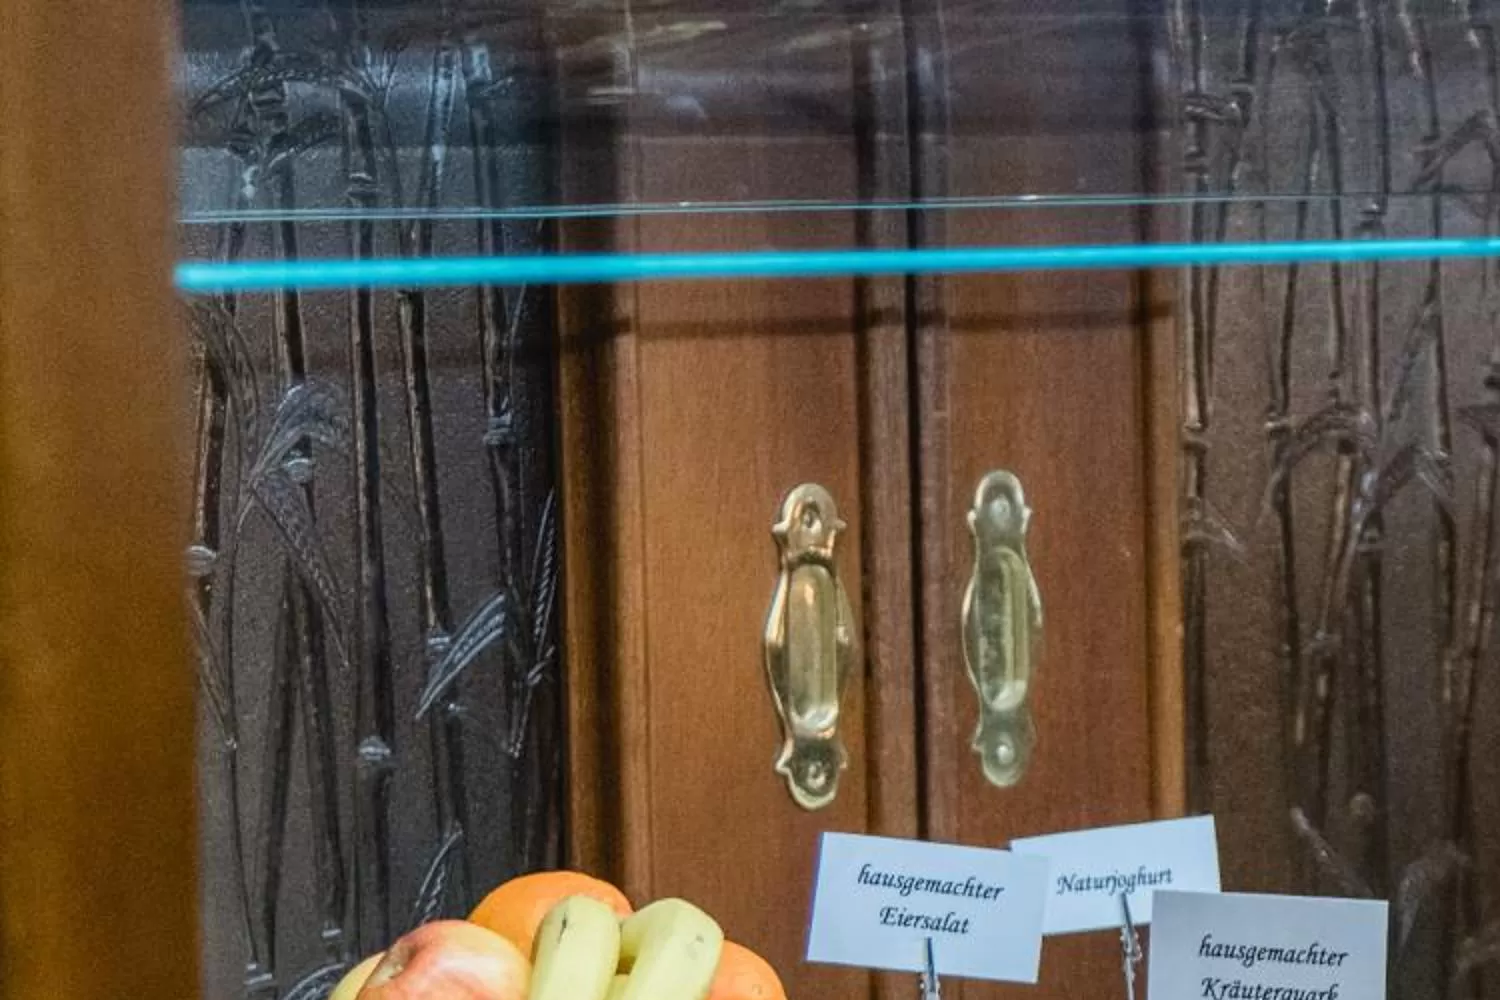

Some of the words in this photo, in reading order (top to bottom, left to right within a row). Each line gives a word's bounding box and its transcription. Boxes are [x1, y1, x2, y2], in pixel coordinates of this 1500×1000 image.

[857, 864, 1005, 900] hausgemachter
[1057, 865, 1172, 895] Naturjoghurt
[879, 906, 969, 934] Eiersalat
[1199, 934, 1348, 967] hausgemachter
